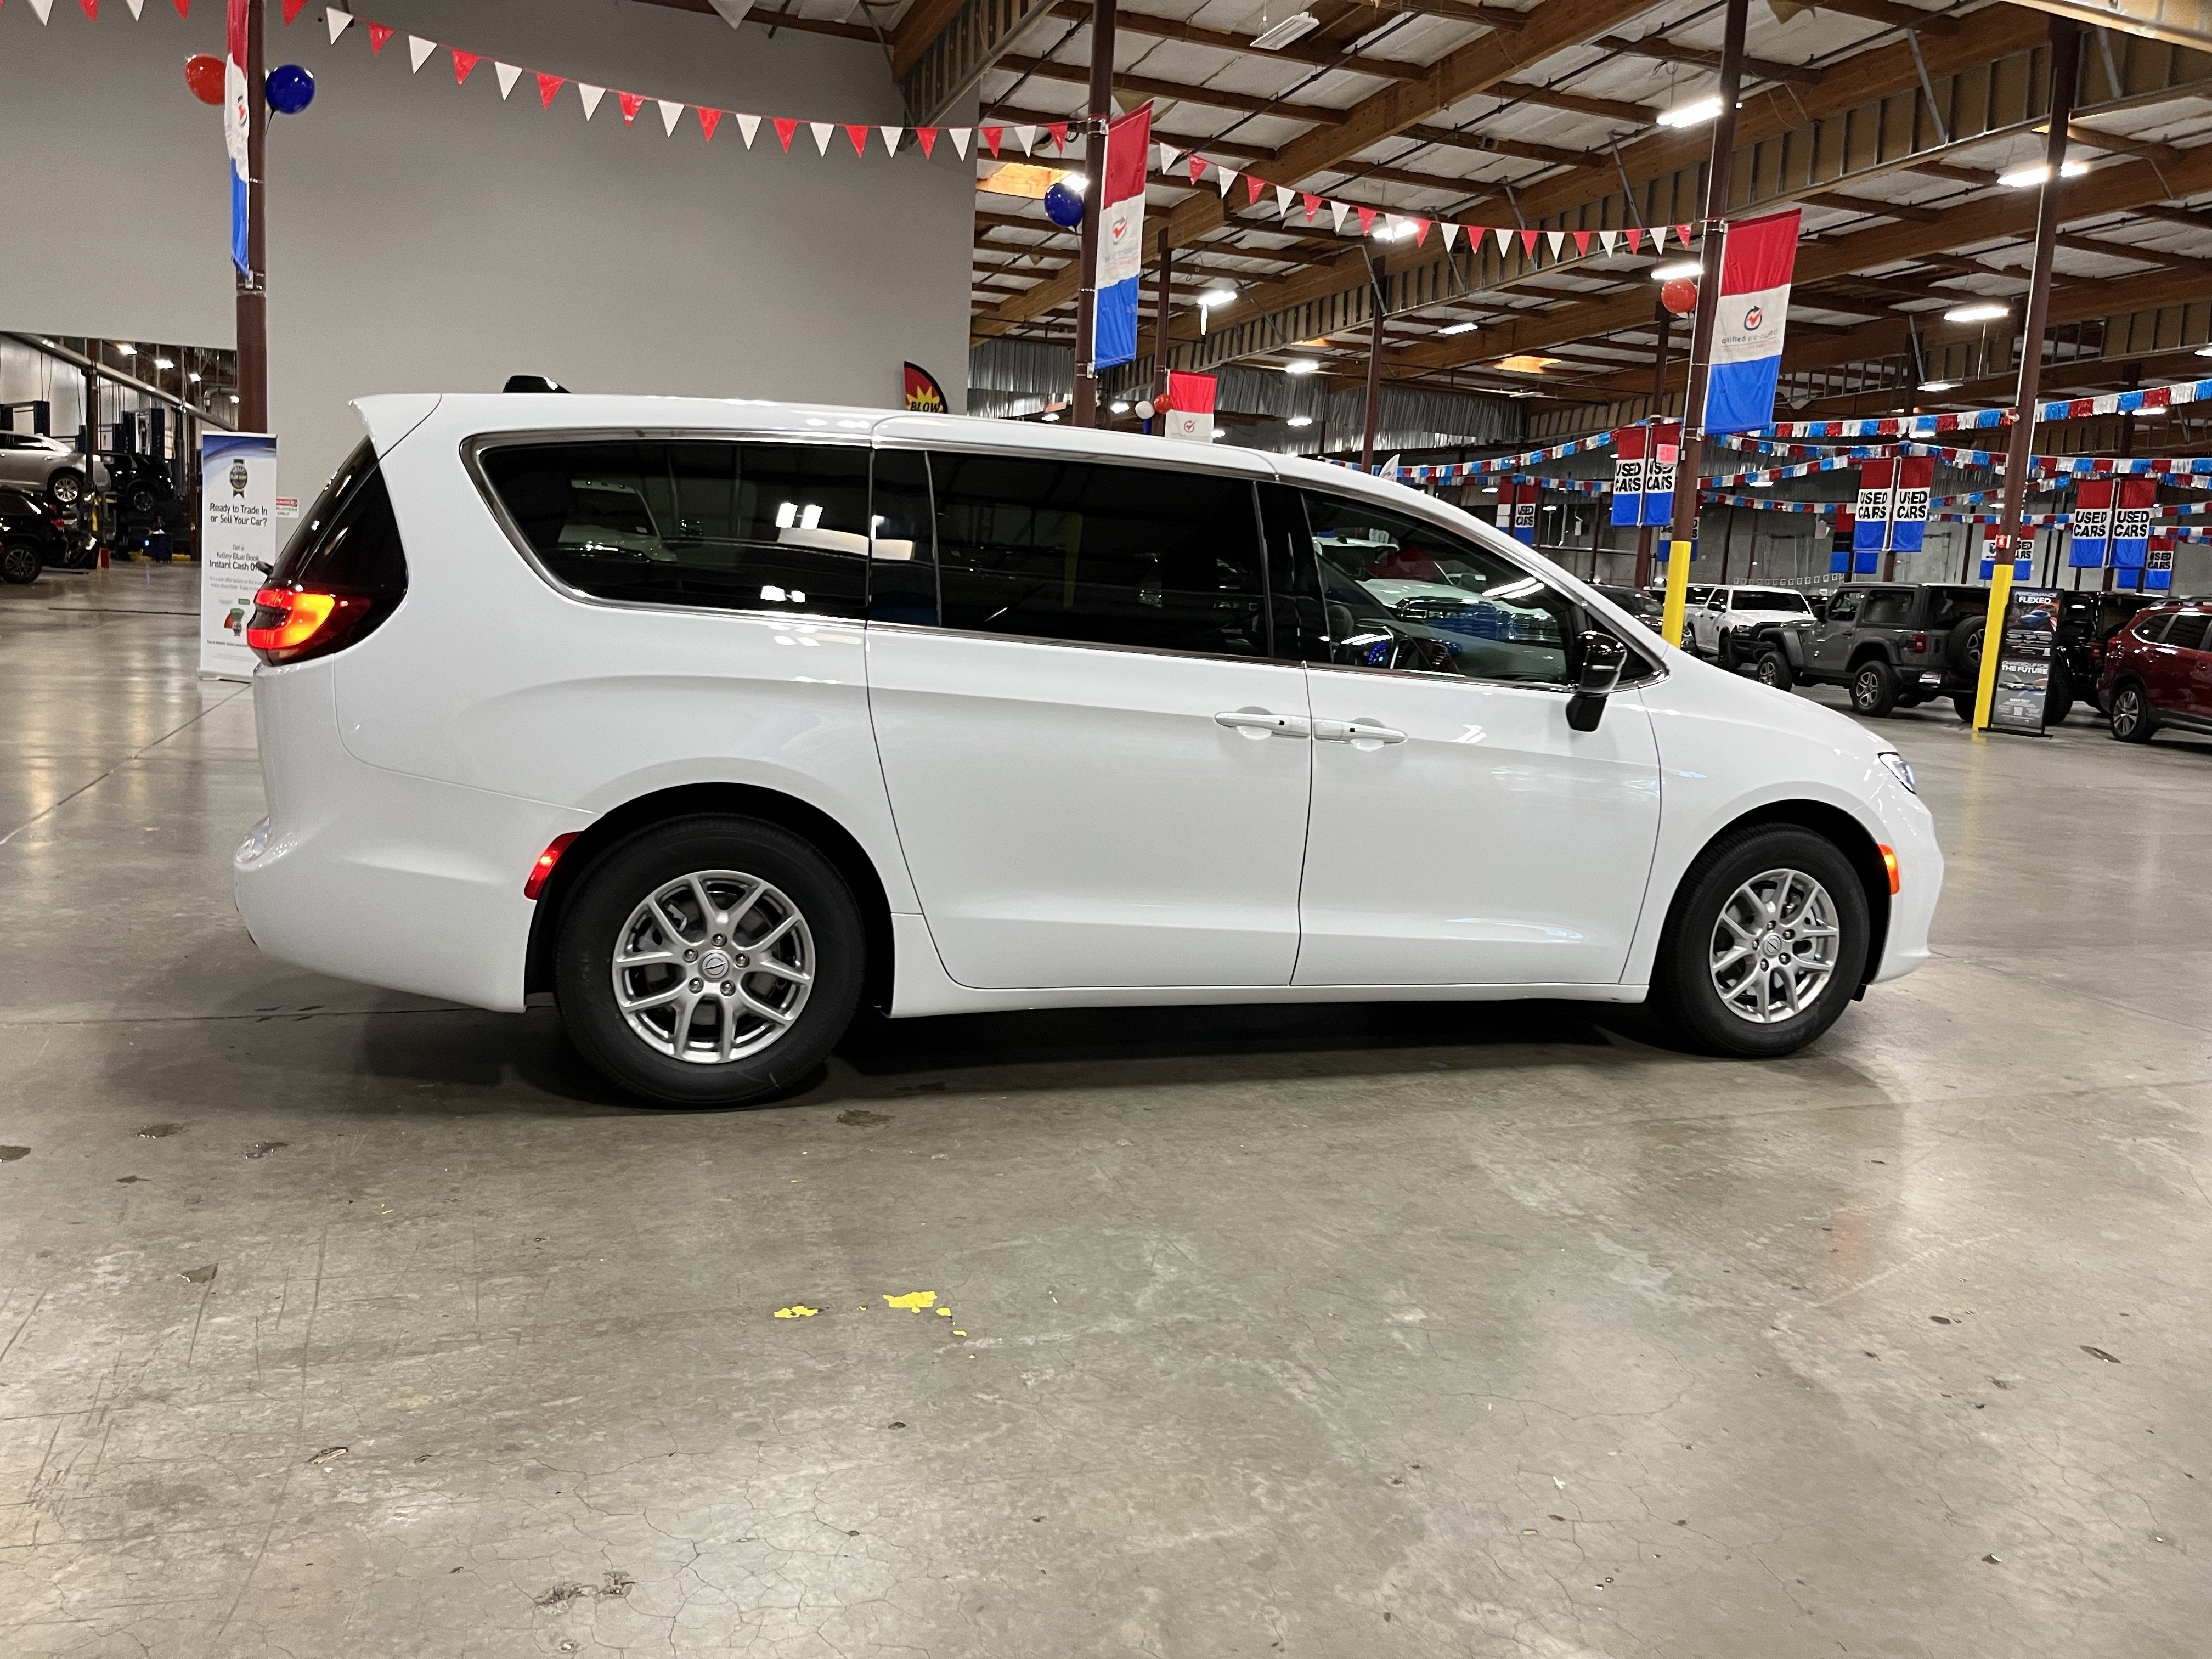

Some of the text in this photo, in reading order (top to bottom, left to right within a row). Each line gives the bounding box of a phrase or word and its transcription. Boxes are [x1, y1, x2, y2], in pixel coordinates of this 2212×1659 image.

[910, 401, 941, 413] BLOW
[1615, 477, 1641, 492] CARS
[1647, 475, 1673, 490] CARS
[1860, 492, 1888, 505] USED
[1899, 490, 1928, 504] USED
[210, 503, 268, 515] Ready to Trade In
[1858, 506, 1887, 519] CARS
[1897, 505, 1926, 519] CARS
[220, 514, 233, 523] Sell
[234, 515, 249, 524] Your
[251, 517, 267, 527] Car?
[2075, 511, 2107, 523] USED
[2117, 511, 2149, 523] USED
[2074, 524, 2106, 537] CARS
[2114, 524, 2147, 537] CARS
[2149, 552, 2171, 561] USED
[210, 559, 232, 569] Instant
[233, 561, 249, 571] Cash
[2148, 561, 2170, 569] CARS
[2019, 596, 2051, 605] FLEXED
[2017, 666, 2048, 674] FUTURE
